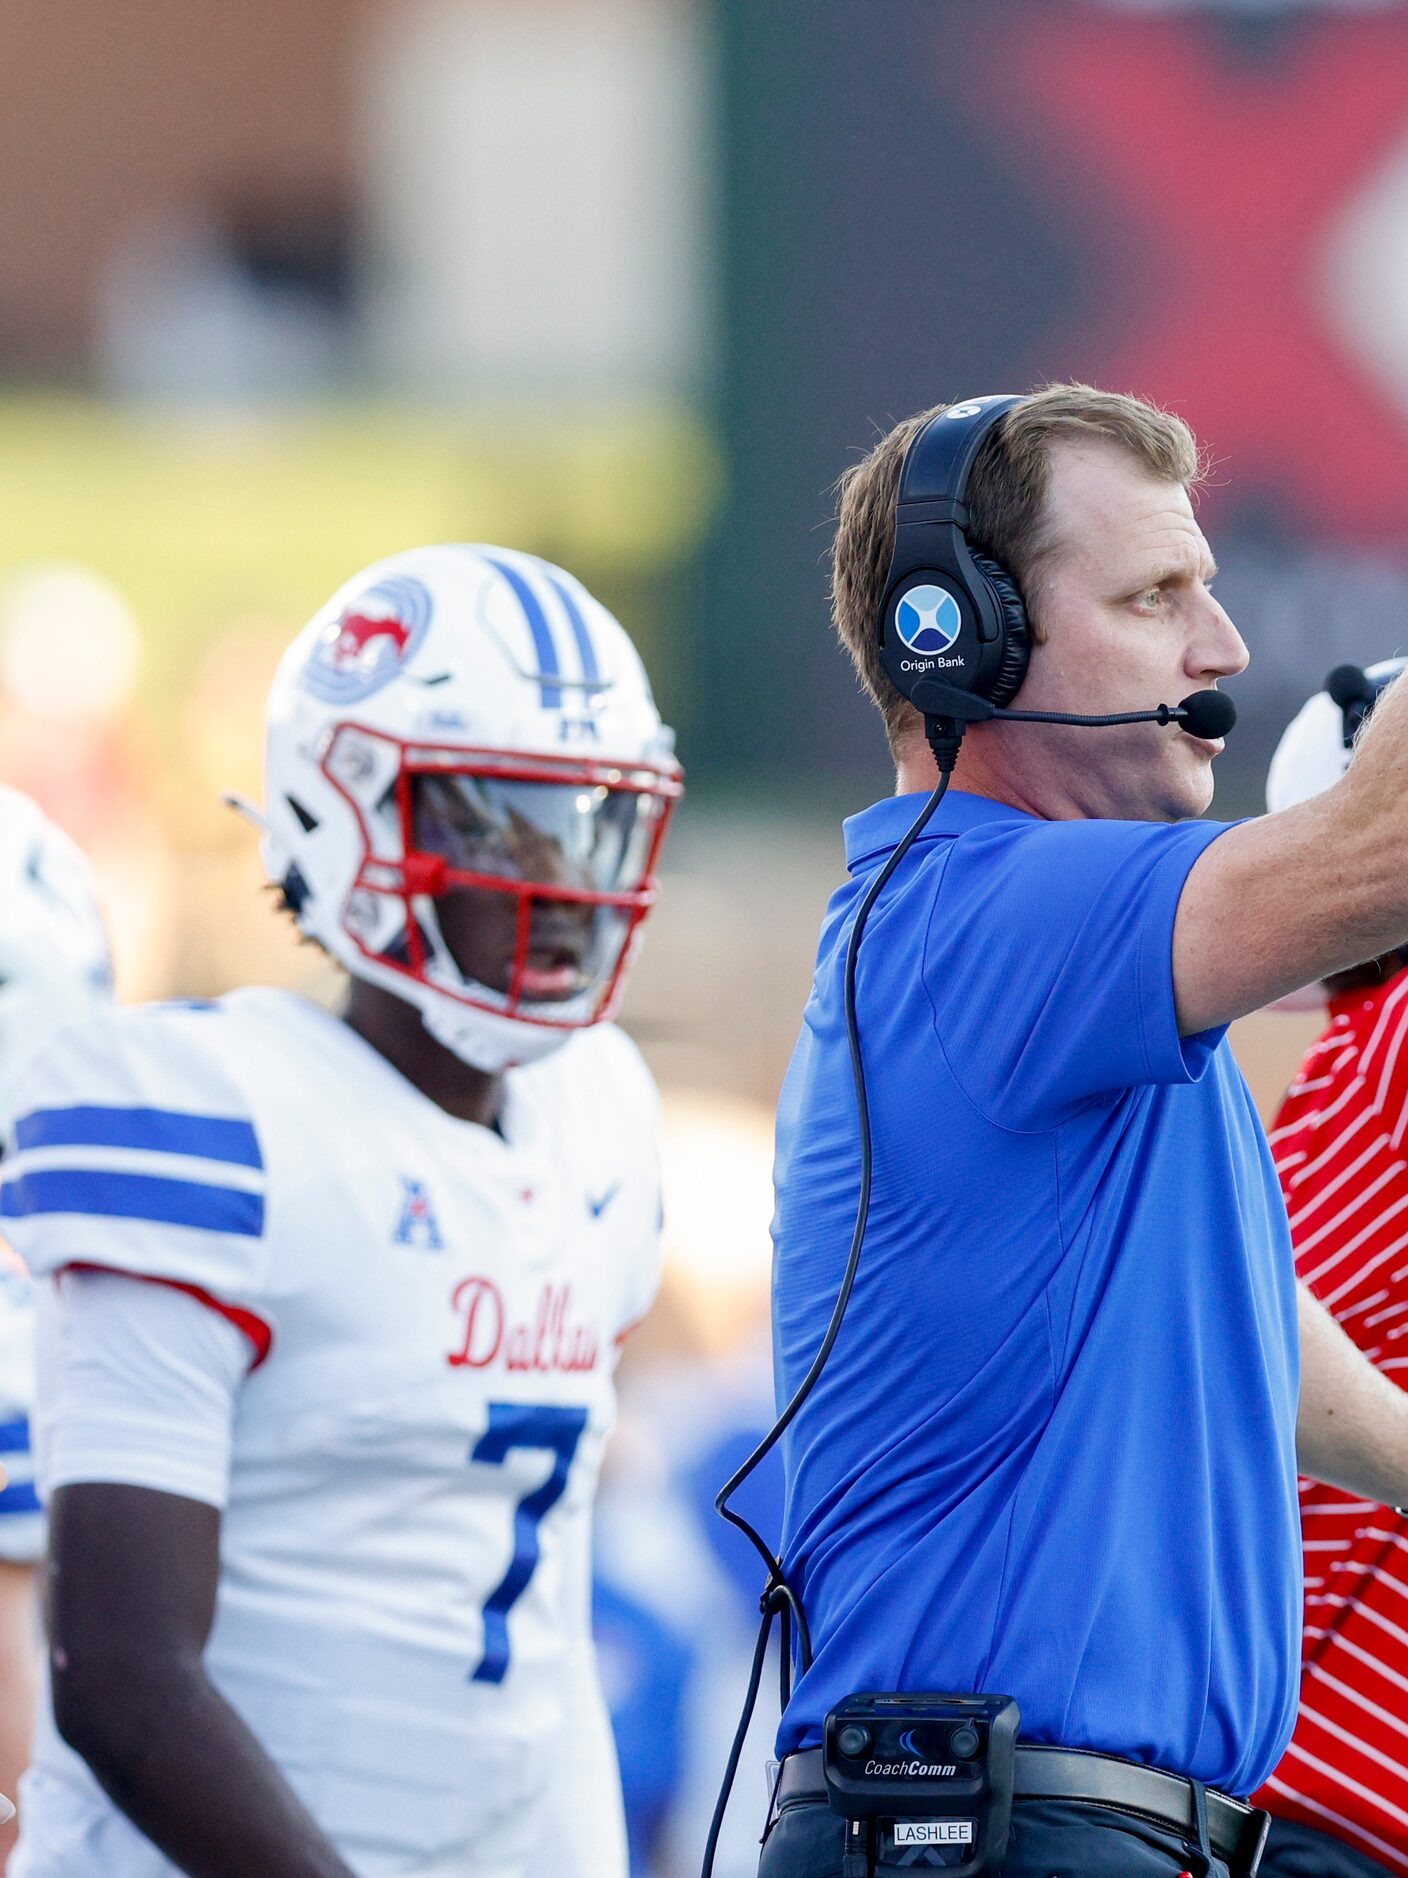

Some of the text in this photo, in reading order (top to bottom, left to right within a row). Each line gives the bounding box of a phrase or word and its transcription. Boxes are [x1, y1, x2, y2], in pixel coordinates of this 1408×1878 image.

[901, 655, 965, 672] Origin Bank
[471, 1402, 588, 1682] 7
[865, 1760, 956, 1776] CoachComm
[896, 1825, 969, 1841] LASHLEE
